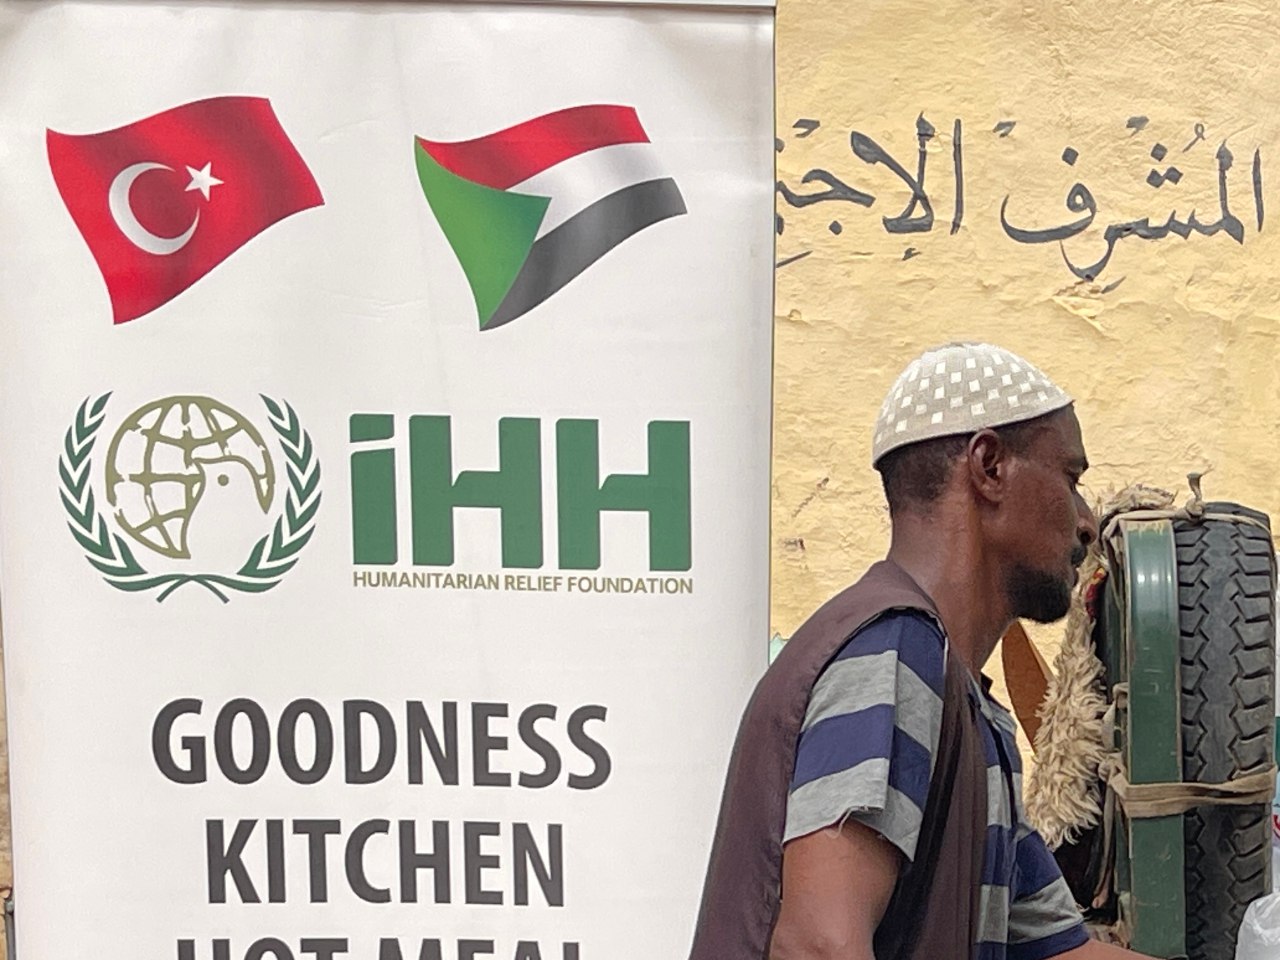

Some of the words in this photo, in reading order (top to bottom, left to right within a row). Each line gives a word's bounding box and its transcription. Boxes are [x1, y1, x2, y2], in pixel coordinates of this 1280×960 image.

[353, 572, 500, 590] HUMANITARIAN
[503, 573, 563, 592] RELIEF
[567, 574, 693, 594] FOUNDATION
[152, 698, 611, 790] GOODNESS
[206, 819, 563, 907] KITCHEN
